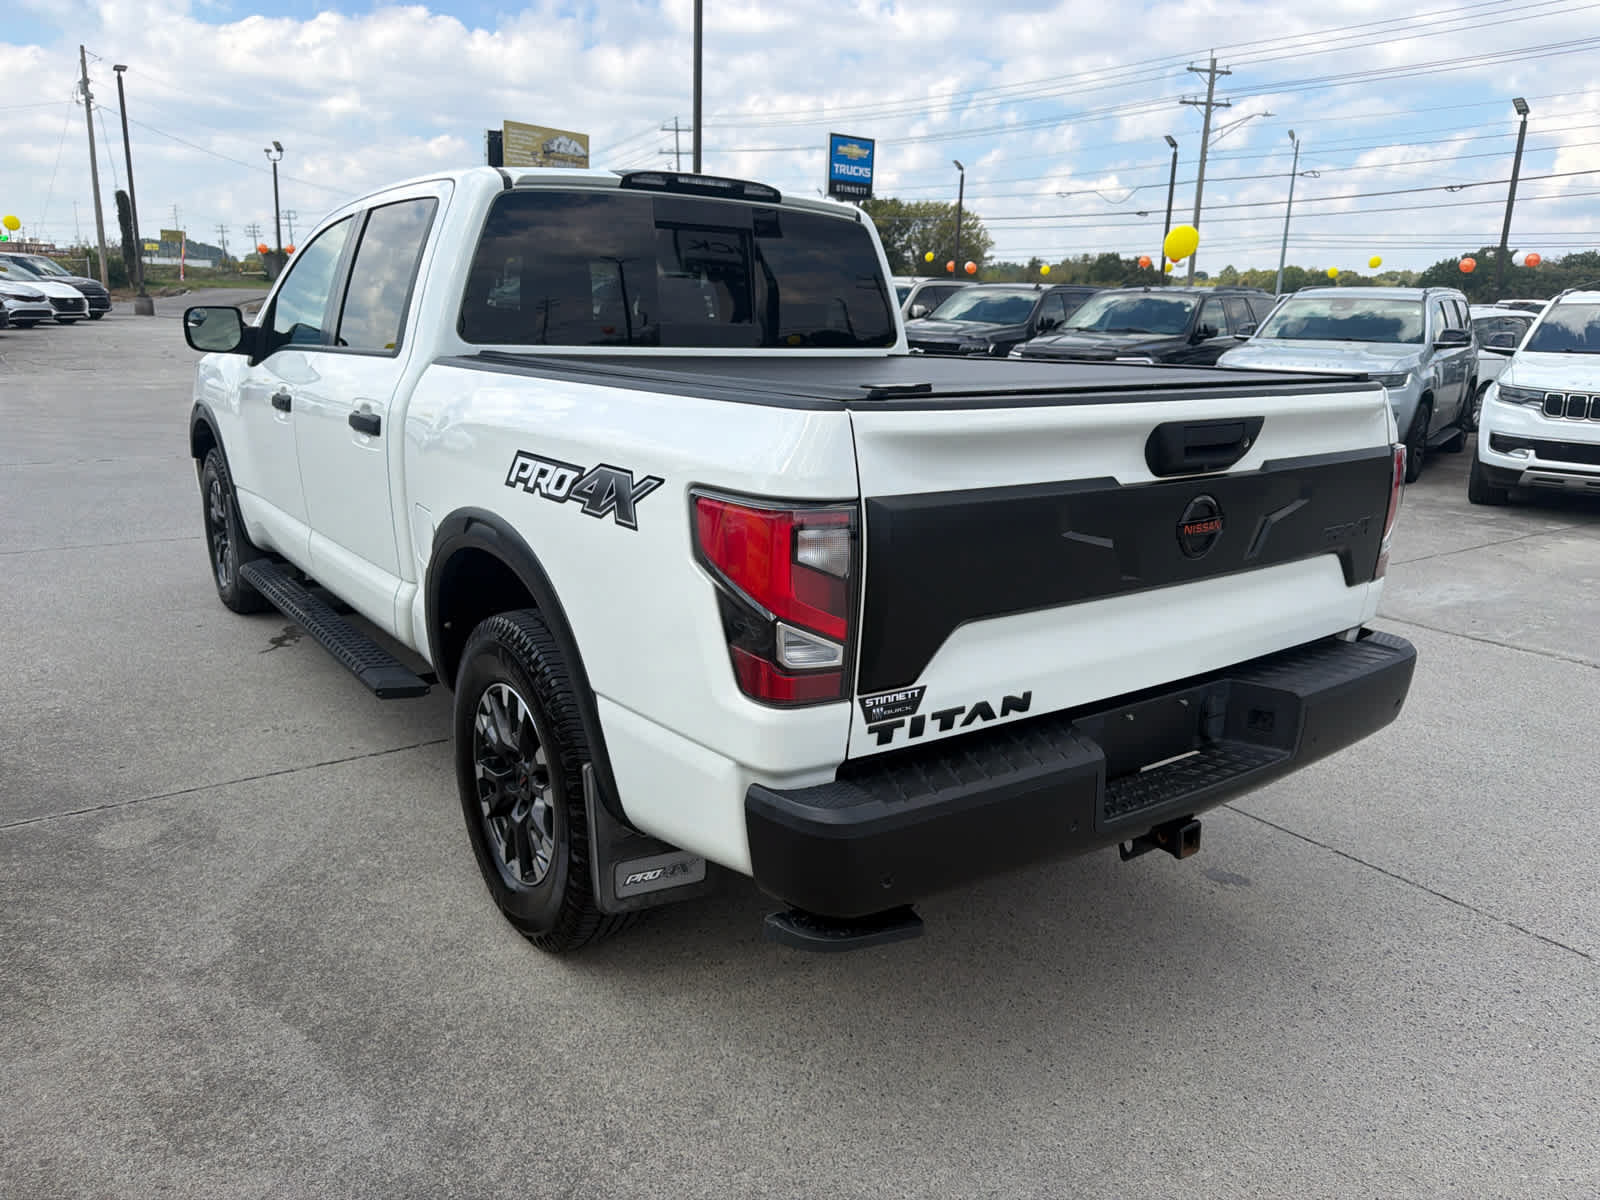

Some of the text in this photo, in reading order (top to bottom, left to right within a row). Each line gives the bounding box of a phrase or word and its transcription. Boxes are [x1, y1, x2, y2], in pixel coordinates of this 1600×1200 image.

[833, 163, 871, 178] TRUCKS
[836, 184, 867, 195] STINNETT
[1184, 520, 1221, 535] NISSAN
[865, 689, 921, 707] STINNETT
[883, 705, 913, 716] BUICK
[867, 691, 1032, 746] TITAN
